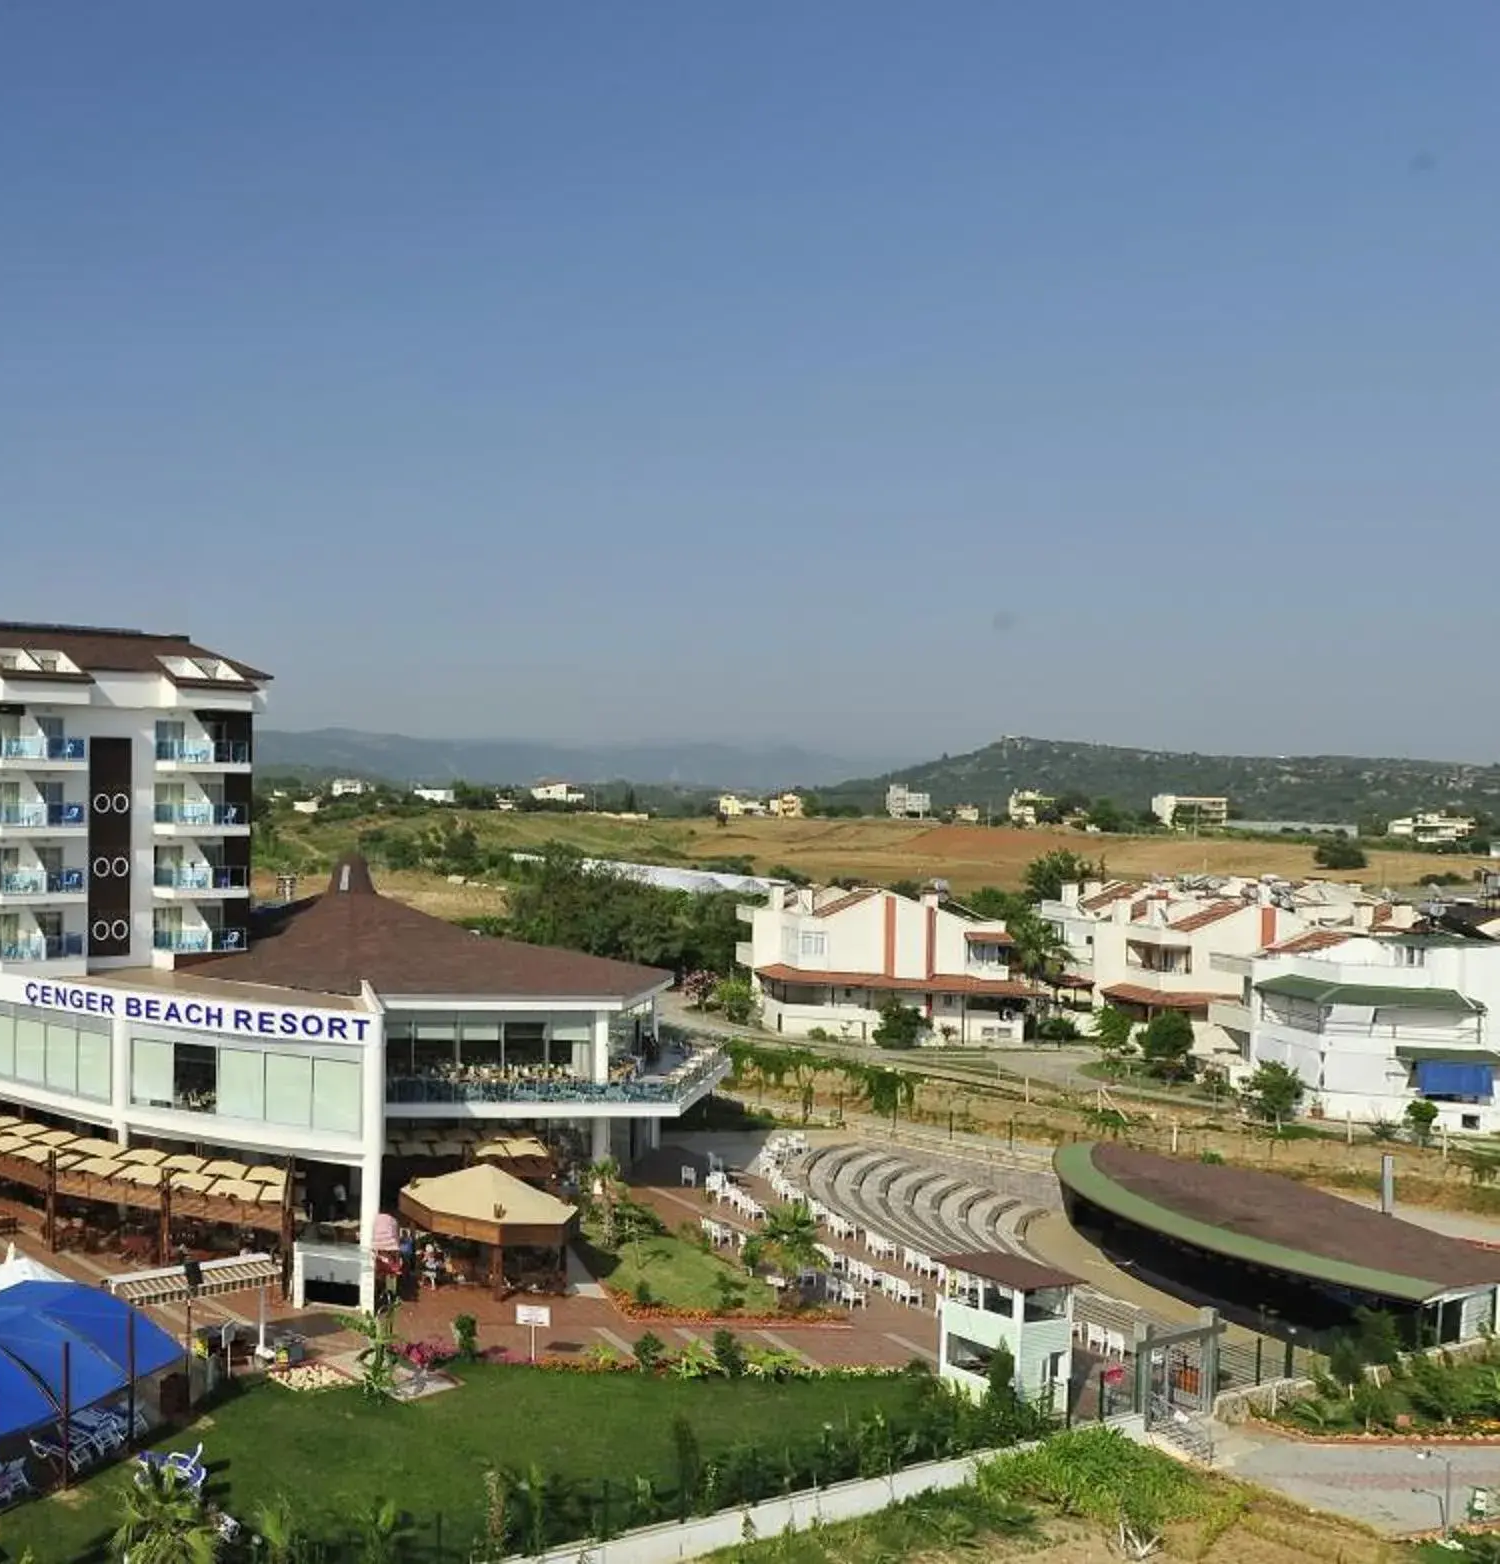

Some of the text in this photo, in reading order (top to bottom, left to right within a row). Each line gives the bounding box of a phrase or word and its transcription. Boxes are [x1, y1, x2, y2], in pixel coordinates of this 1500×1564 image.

[25, 982, 371, 1041] ÇENGER BEACH RESORT
